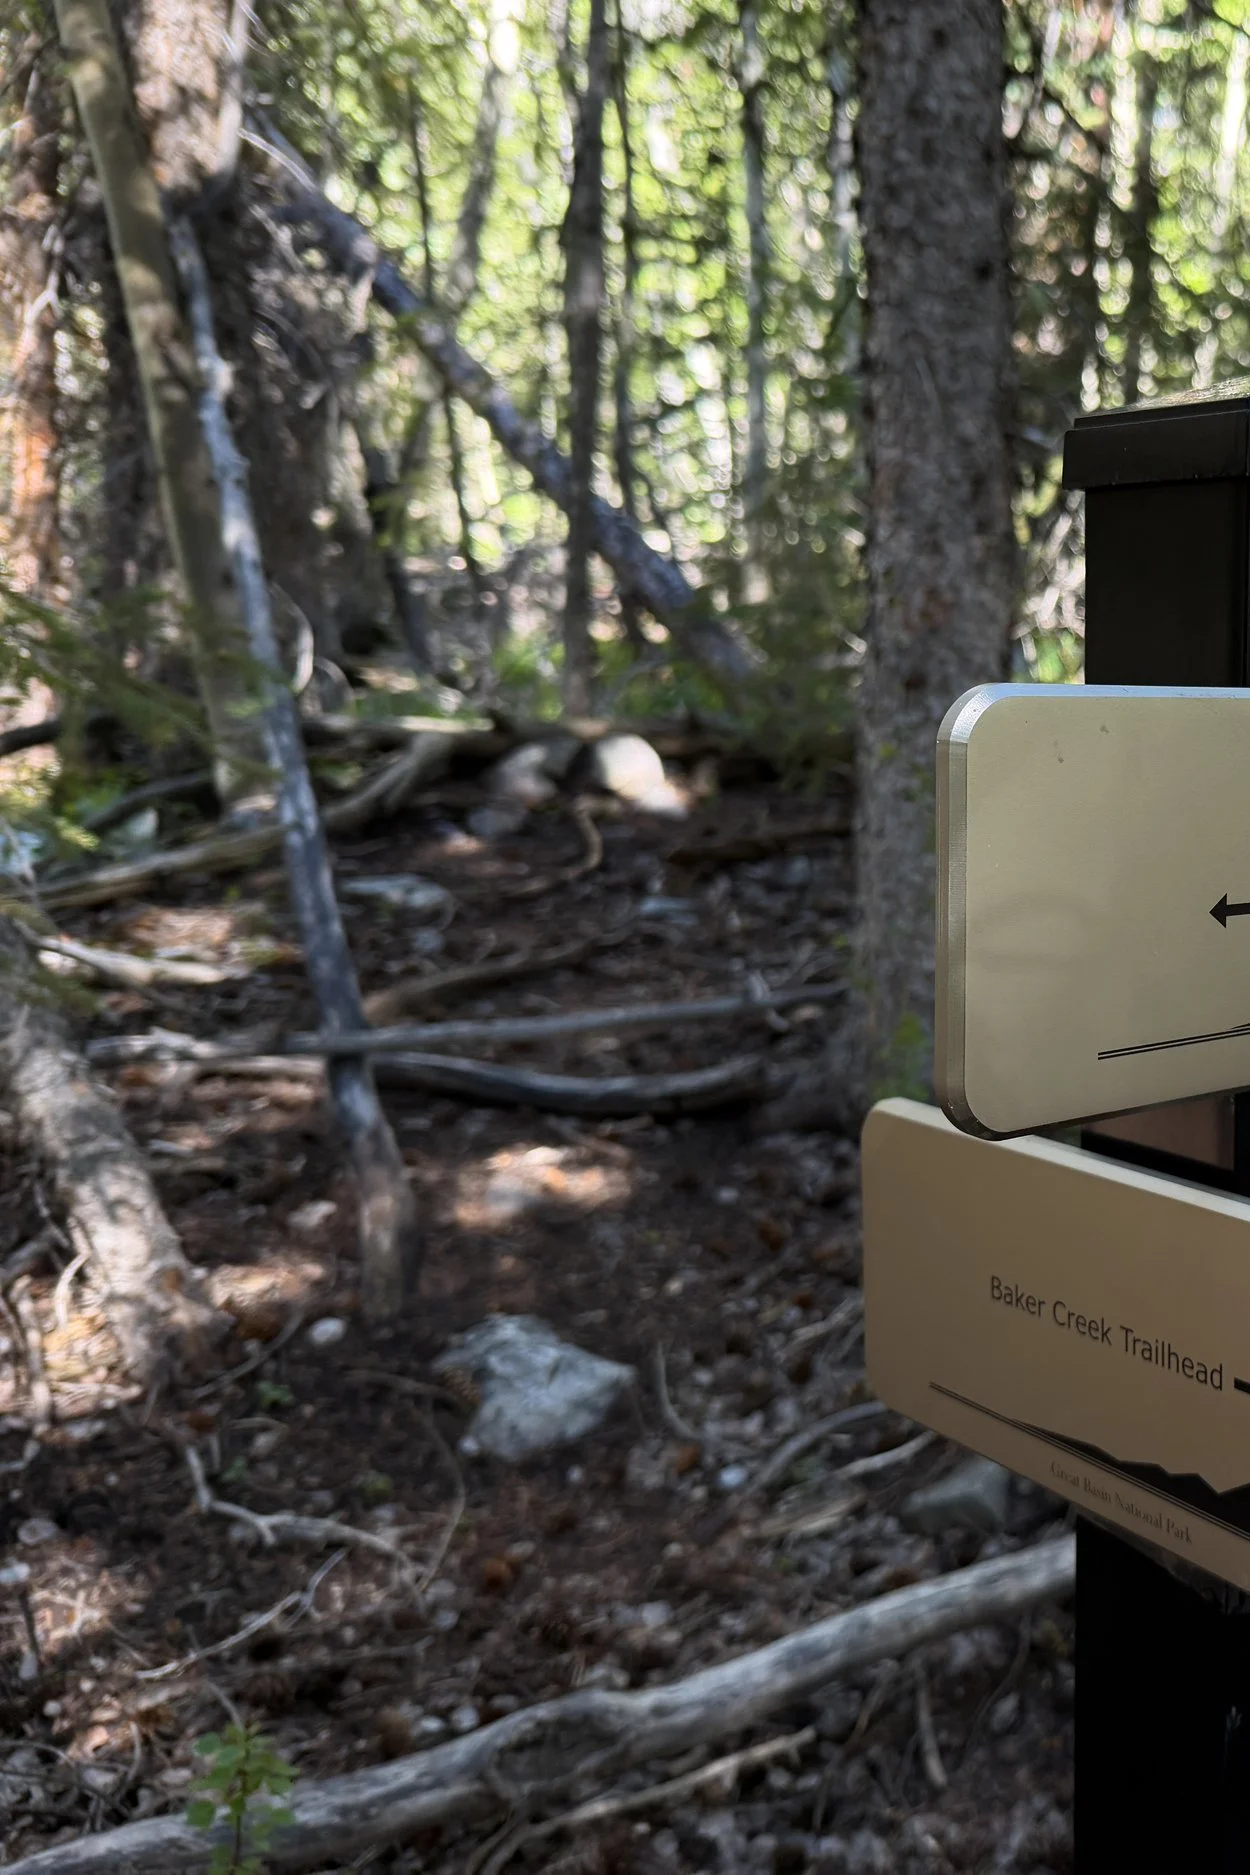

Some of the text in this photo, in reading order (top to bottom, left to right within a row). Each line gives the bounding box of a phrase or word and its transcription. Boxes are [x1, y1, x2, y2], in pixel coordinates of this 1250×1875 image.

[990, 1274, 1047, 1318] Baker
[1052, 1299, 1113, 1346] Creek
[1119, 1325, 1224, 1391] Trailhead
[1049, 1460, 1192, 1544] Great Basin National Park
